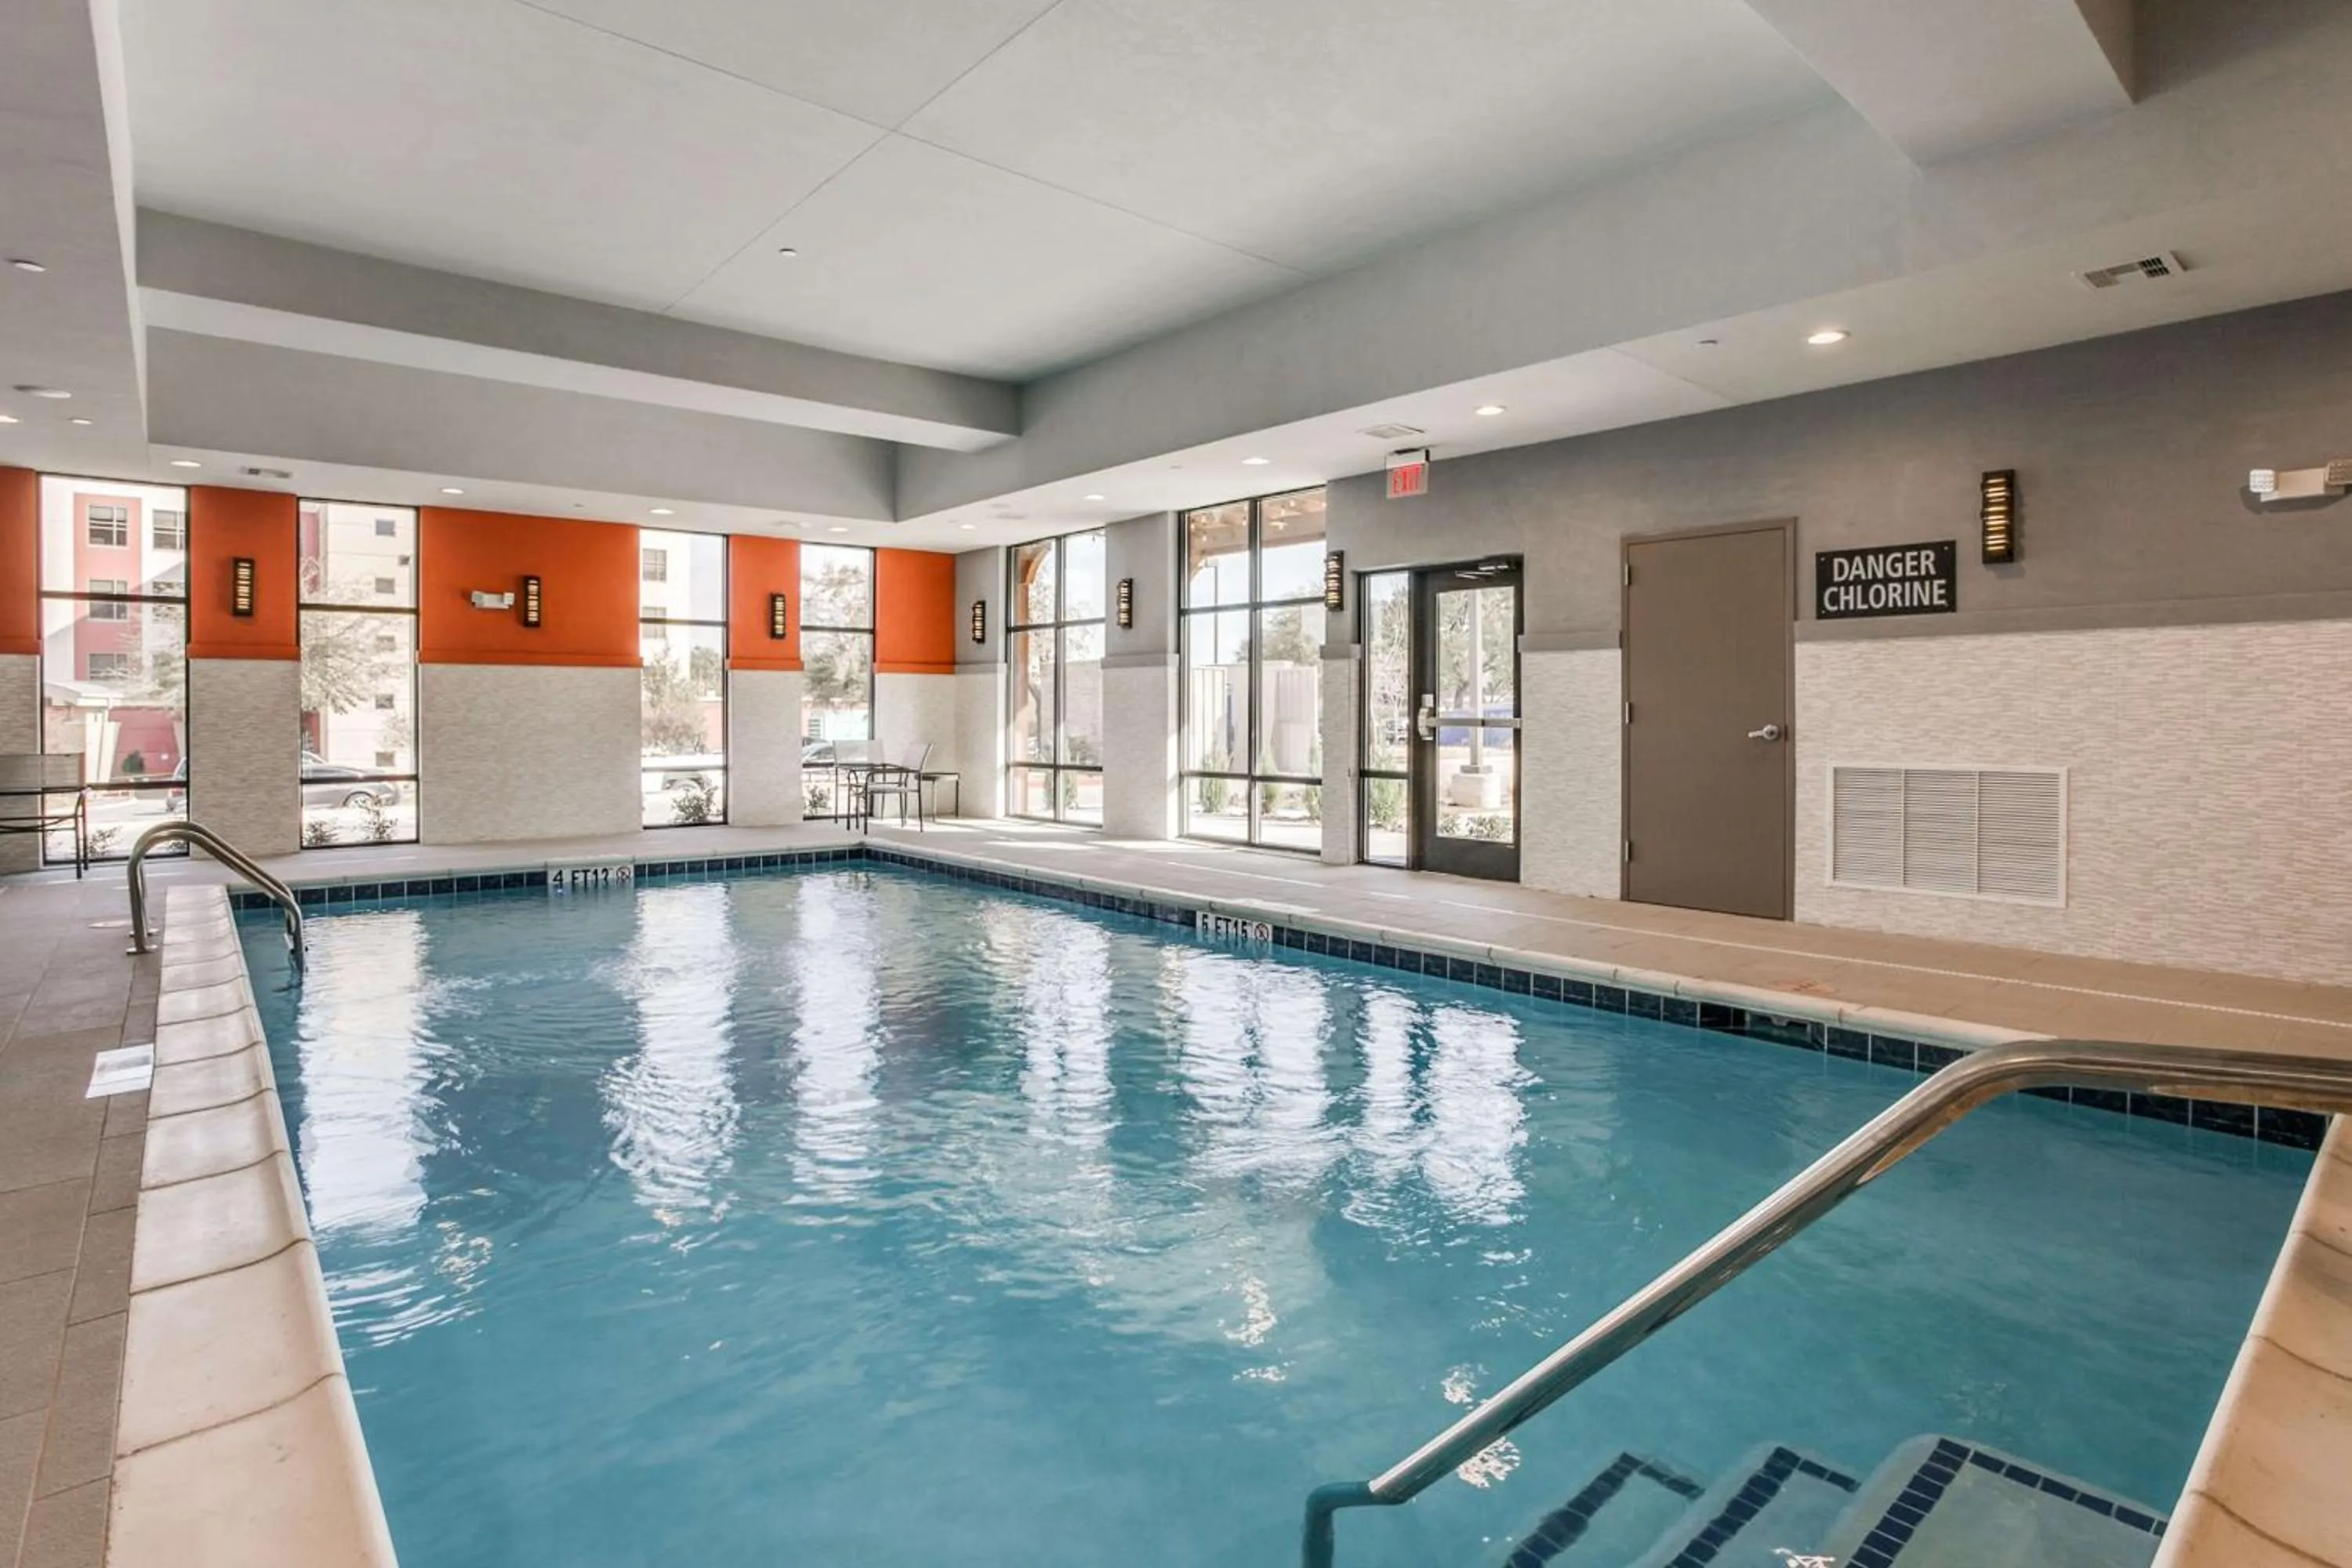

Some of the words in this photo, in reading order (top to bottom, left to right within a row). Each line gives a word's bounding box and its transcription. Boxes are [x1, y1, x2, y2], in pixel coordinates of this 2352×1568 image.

[1392, 466, 1422, 494] EXIT
[1832, 550, 1936, 583] DANGER
[1823, 579, 1947, 612] CHLORINE
